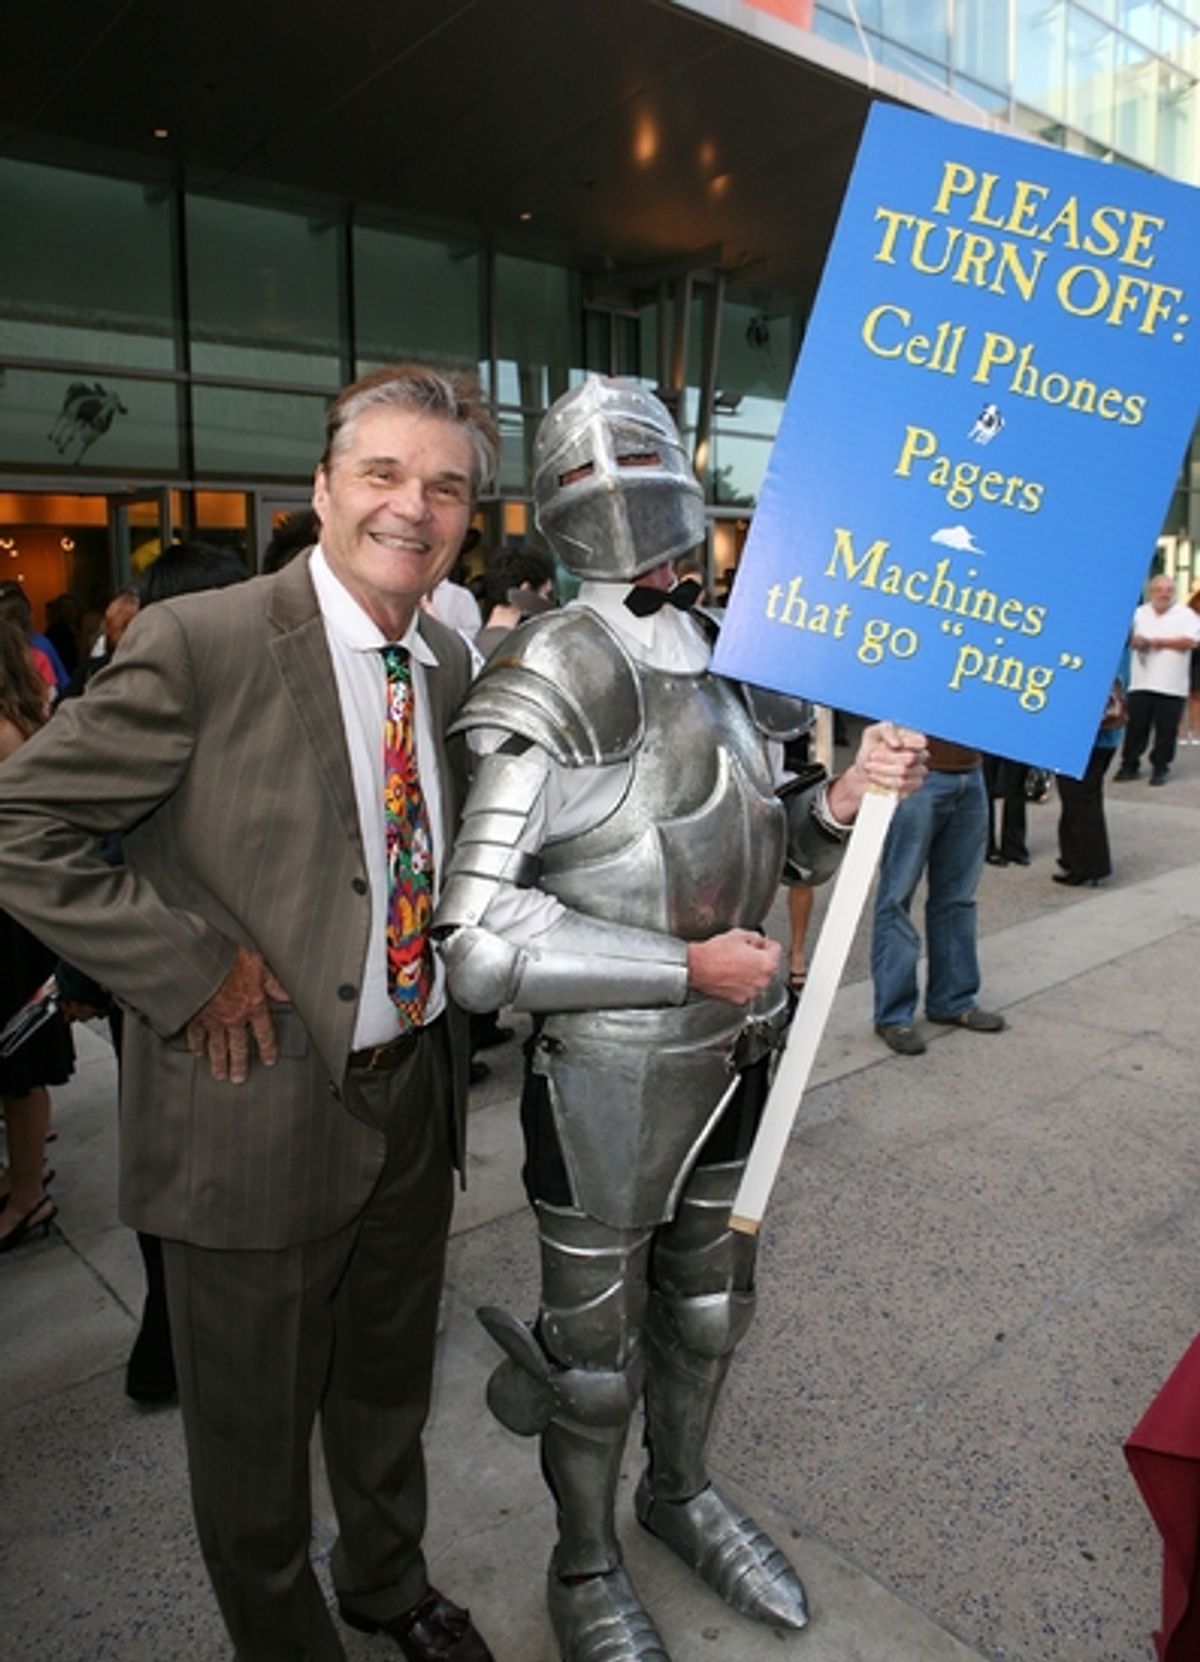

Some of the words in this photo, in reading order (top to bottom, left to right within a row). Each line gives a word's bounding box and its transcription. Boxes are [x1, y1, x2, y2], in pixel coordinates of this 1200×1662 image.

[932, 161, 1166, 271] PLEASE
[873, 207, 1048, 302] TURN
[1056, 264, 1191, 345] OFF:
[861, 303, 967, 376] Cell
[972, 331, 1148, 428] Phones
[894, 424, 1047, 515] Pagers
[763, 578, 852, 643] that
[855, 615, 919, 665] go
[824, 527, 1047, 638] Machines
